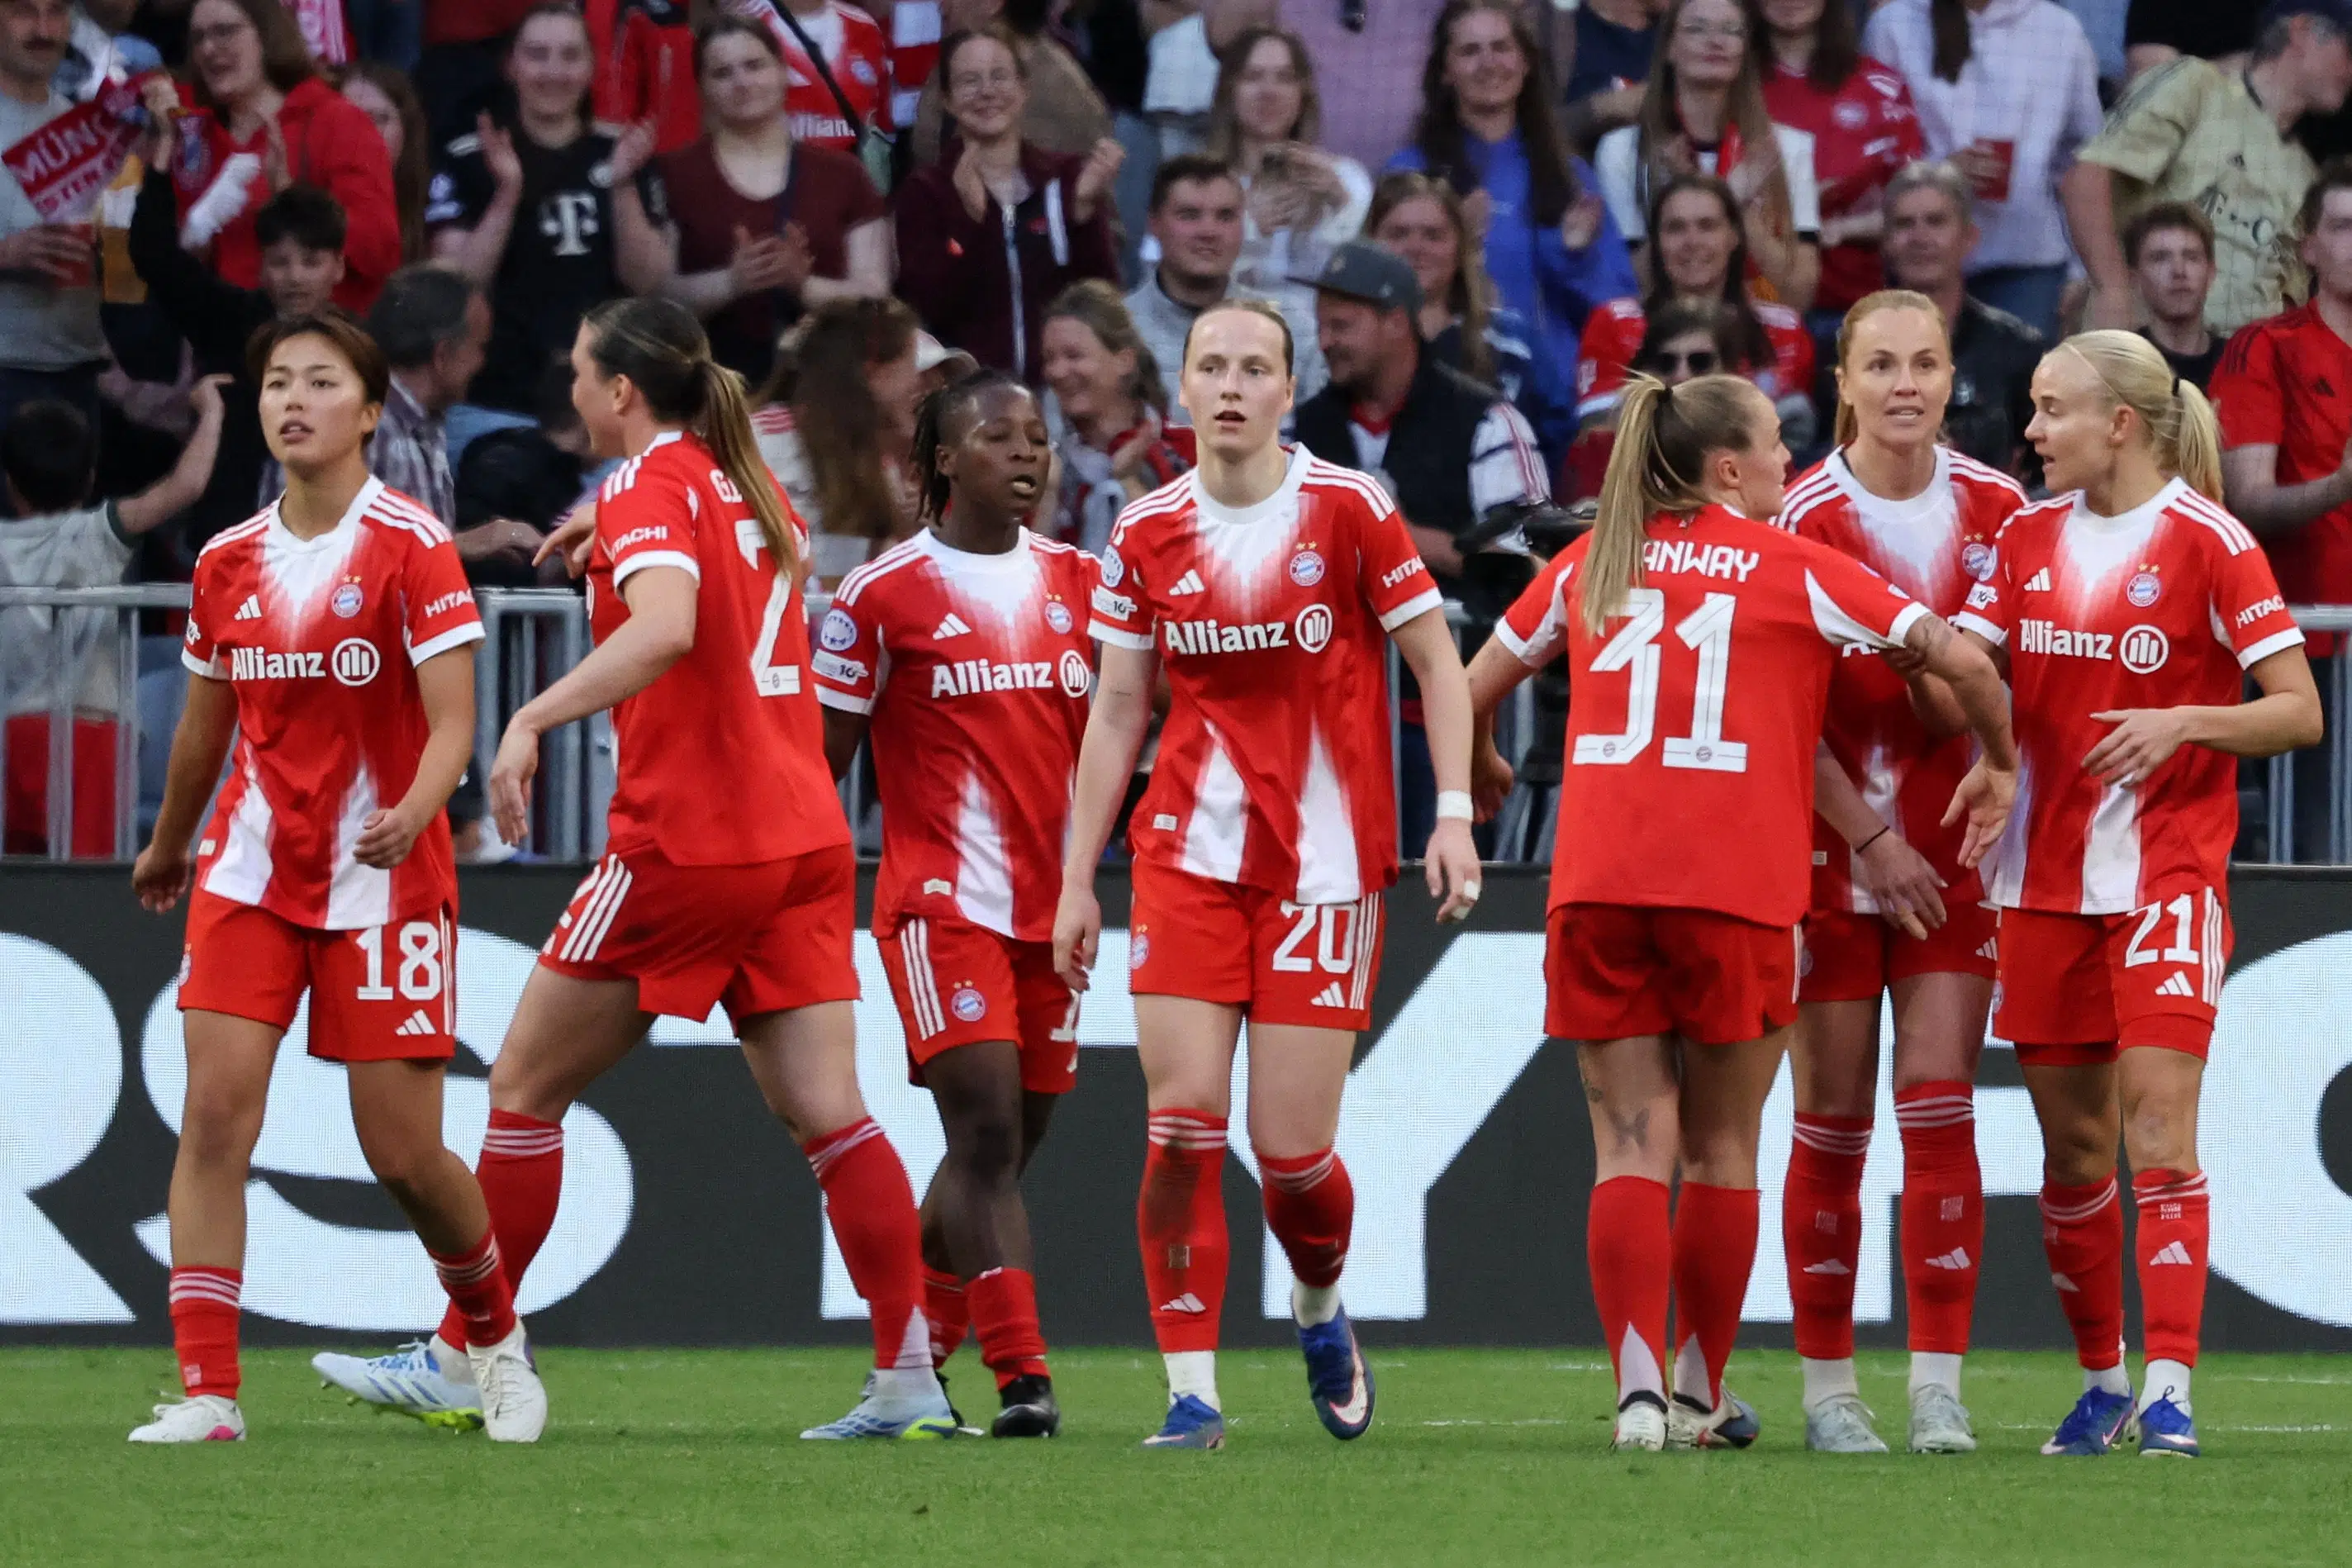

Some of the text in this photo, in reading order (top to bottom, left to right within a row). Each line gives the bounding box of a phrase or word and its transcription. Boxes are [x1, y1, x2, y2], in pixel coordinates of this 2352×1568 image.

[710, 468, 743, 503] GI
[612, 525, 668, 553] TACHI
[1382, 554, 1426, 588] HITA
[1643, 539, 1760, 582] ANWAY
[2236, 594, 2286, 629] HITAC
[1163, 620, 1290, 655] Allianz
[2020, 618, 2114, 661] Allianz
[231, 646, 326, 681] Allianz
[932, 658, 1054, 699] Allianz
[1572, 587, 1748, 773] 31
[1272, 900, 1359, 974] 20
[2125, 893, 2200, 968] 21
[355, 921, 442, 1000] 18
[1049, 987, 1080, 1043] 1
